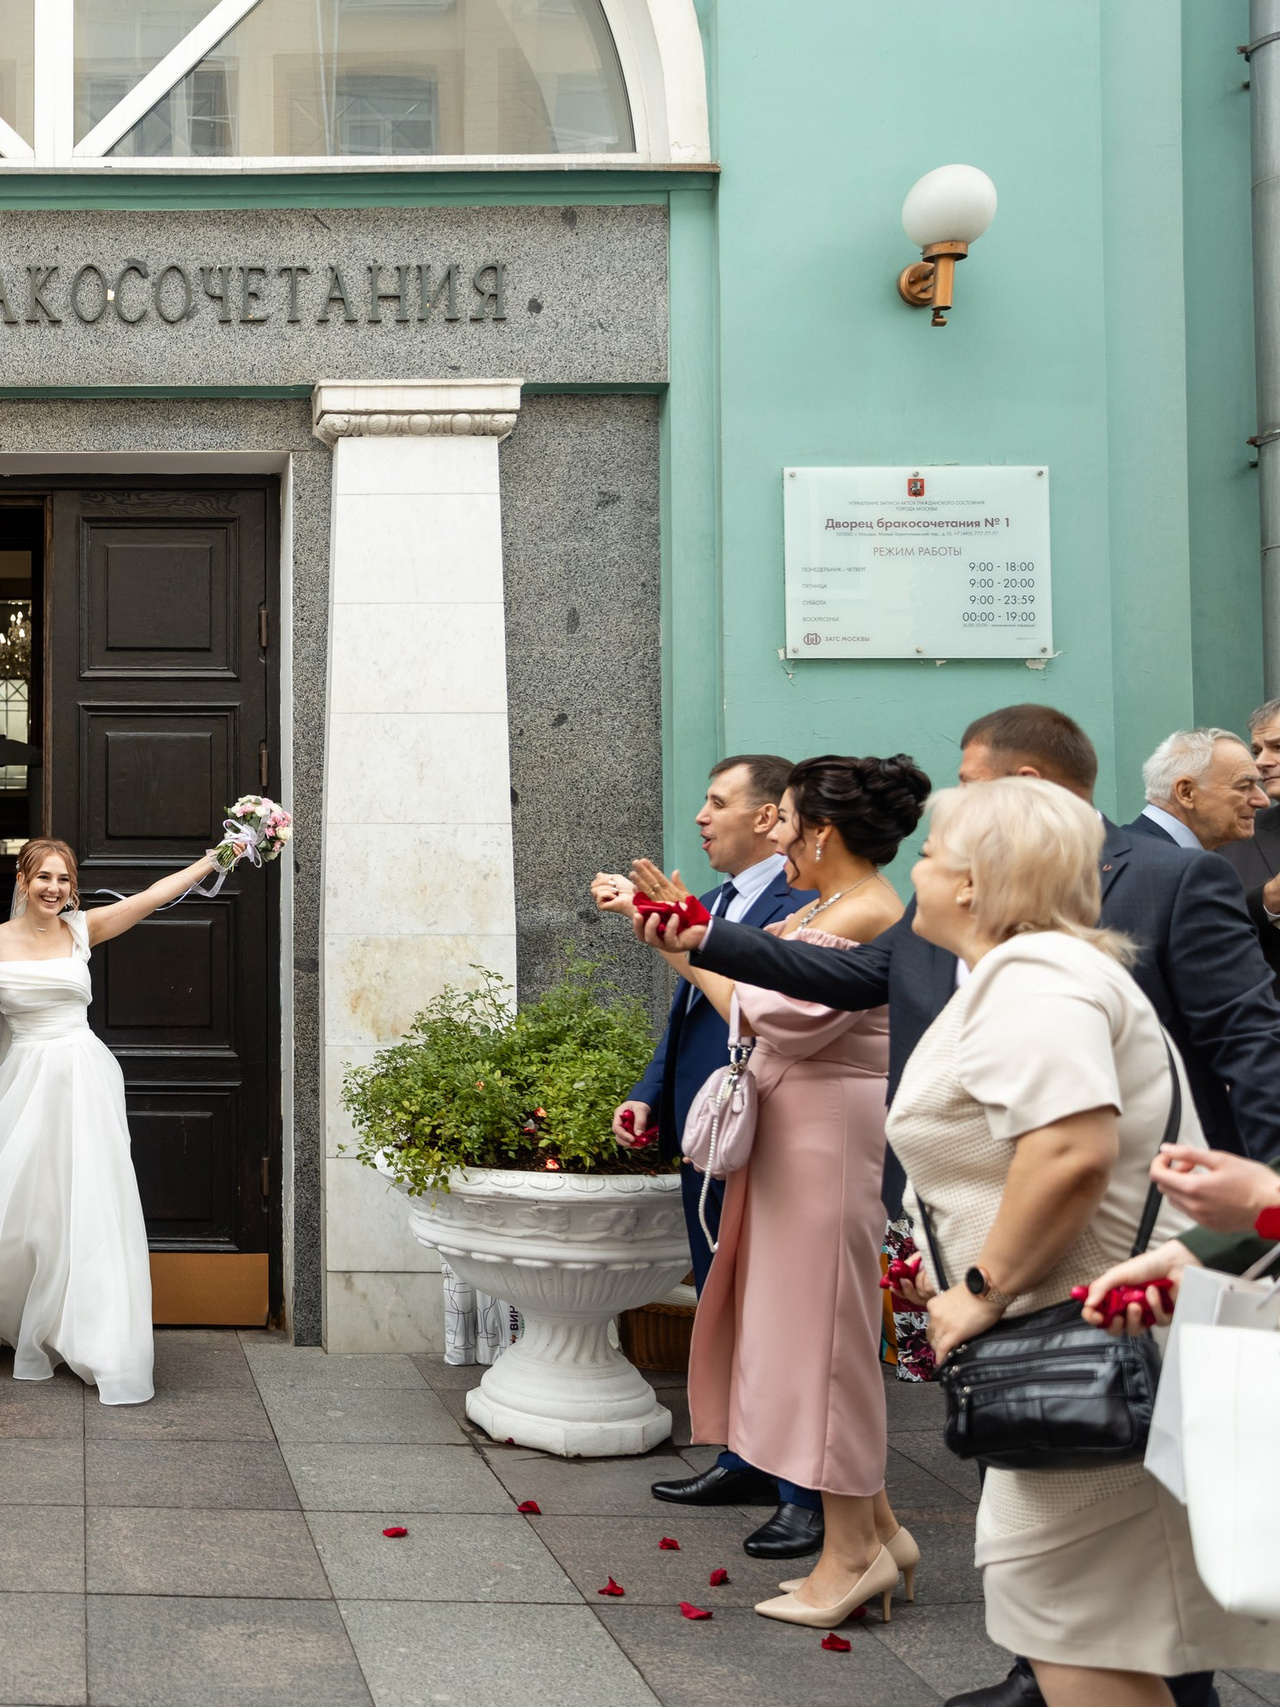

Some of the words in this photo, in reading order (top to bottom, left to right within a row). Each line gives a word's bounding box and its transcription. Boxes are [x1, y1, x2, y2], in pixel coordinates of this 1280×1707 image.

[825, 518, 873, 531] Дворец
[877, 517, 980, 531] бракосочетания
[985, 518, 1000, 528] №
[1004, 517, 1010, 528] 1
[873, 546, 915, 557] РЕЖИМ
[919, 546, 962, 557] РАБОТЫ
[968, 561, 994, 572] 9:00
[1005, 561, 1035, 572] 18:00
[969, 578, 994, 589] 9:00
[1003, 578, 1035, 589] 20:00
[969, 594, 994, 605] 9:00
[1004, 594, 1035, 605] 23:59
[962, 611, 995, 622] 00:00
[1006, 611, 1036, 622] 19:00
